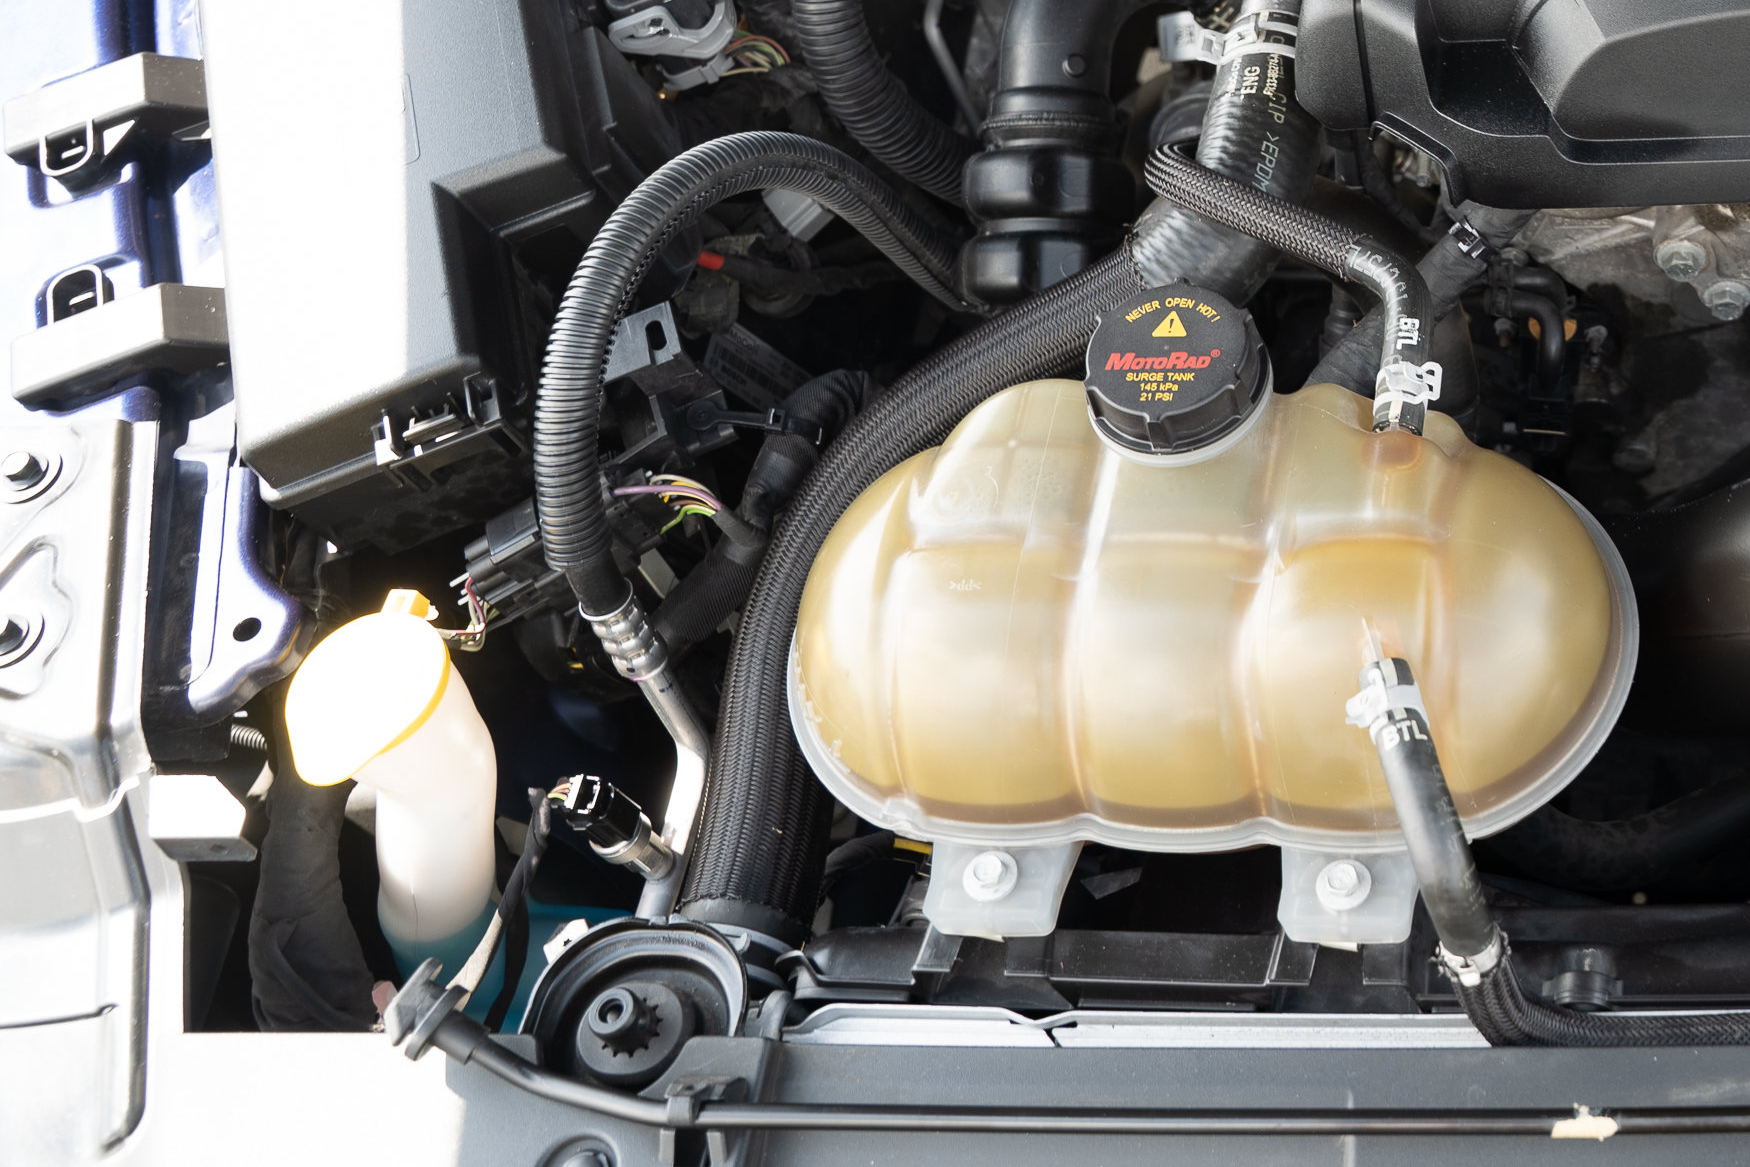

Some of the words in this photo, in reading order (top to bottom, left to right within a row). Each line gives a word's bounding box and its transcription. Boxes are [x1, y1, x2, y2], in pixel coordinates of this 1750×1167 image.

[1124, 299, 1161, 323] NEVER
[1165, 297, 1195, 309] OPEN
[1396, 318, 1420, 350] BTL
[1125, 372, 1164, 382] SURGE
[1167, 372, 1195, 382] TANK
[1139, 383, 1158, 391] 145
[1159, 382, 1179, 392] kPa
[1139, 393, 1152, 402] 21
[1154, 393, 1174, 402] PSI
[1383, 720, 1428, 750] BTL
